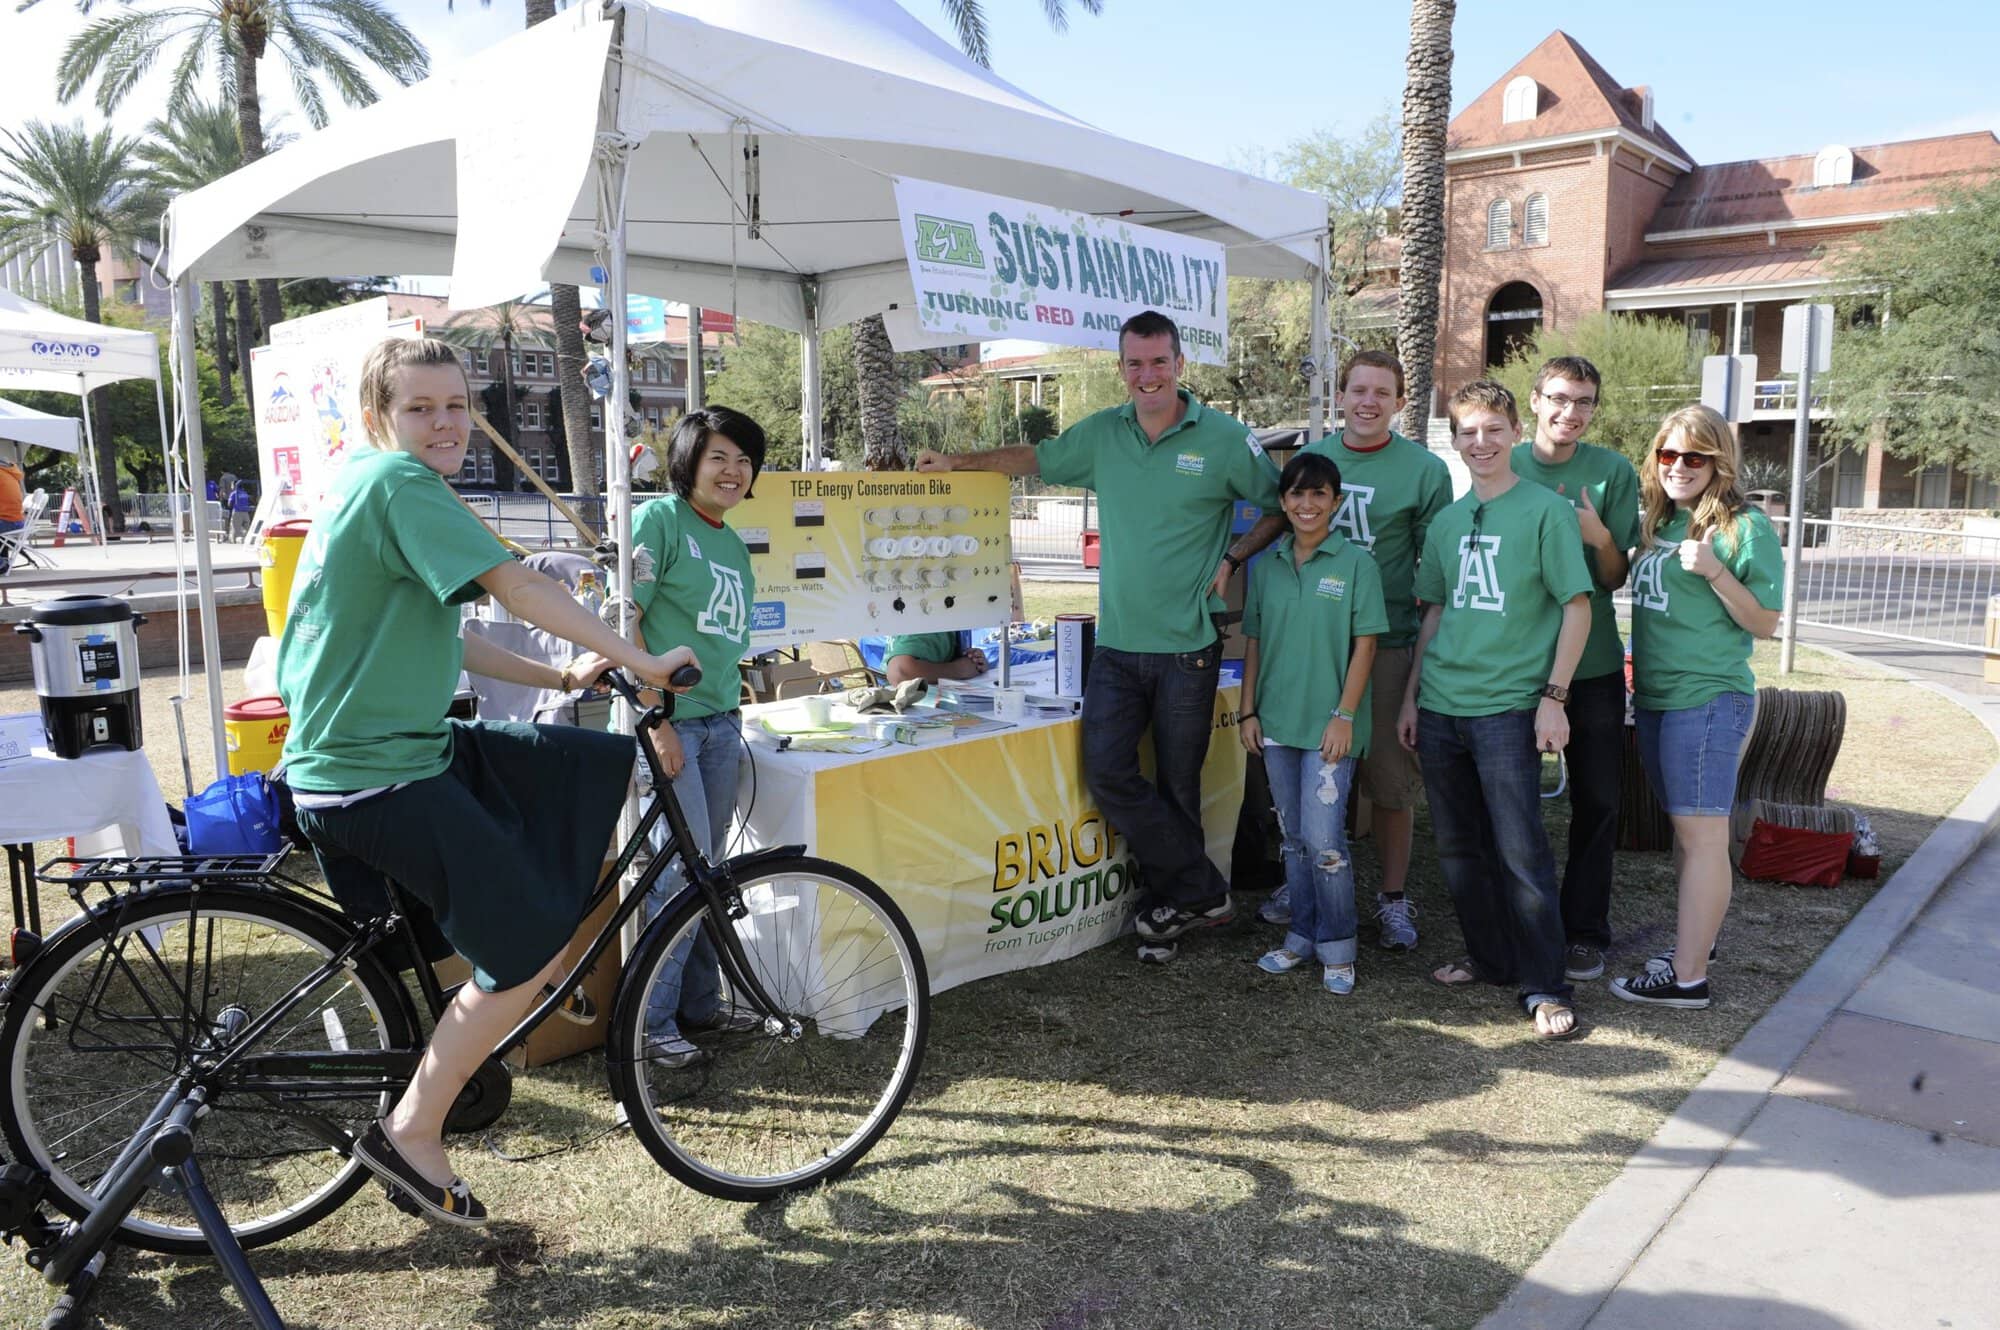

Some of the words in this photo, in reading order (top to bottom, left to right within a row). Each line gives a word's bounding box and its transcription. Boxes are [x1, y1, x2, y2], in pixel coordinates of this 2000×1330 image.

[988, 212, 1219, 317] SUSTAINABILITY
[924, 290, 1029, 321] TURNING
[1035, 304, 1075, 327] RED
[1082, 314, 1121, 332] AND
[1180, 328, 1223, 348] GREEN
[32, 341, 101, 358] KAMP
[790, 480, 812, 497] TEP
[816, 480, 853, 500] Energy
[857, 479, 925, 497] Conservation
[929, 479, 951, 496] Bike
[768, 584, 791, 594] Amps
[801, 583, 824, 592] Watts
[1453, 534, 1506, 611] A
[696, 559, 748, 644] A
[1064, 625, 1073, 653] FUND
[1064, 665, 1073, 690] SAGE
[987, 858, 1143, 934] SOLUTION
[984, 935, 1022, 953] from
[1027, 922, 1074, 946] Tucson
[1078, 906, 1118, 933] Electric
